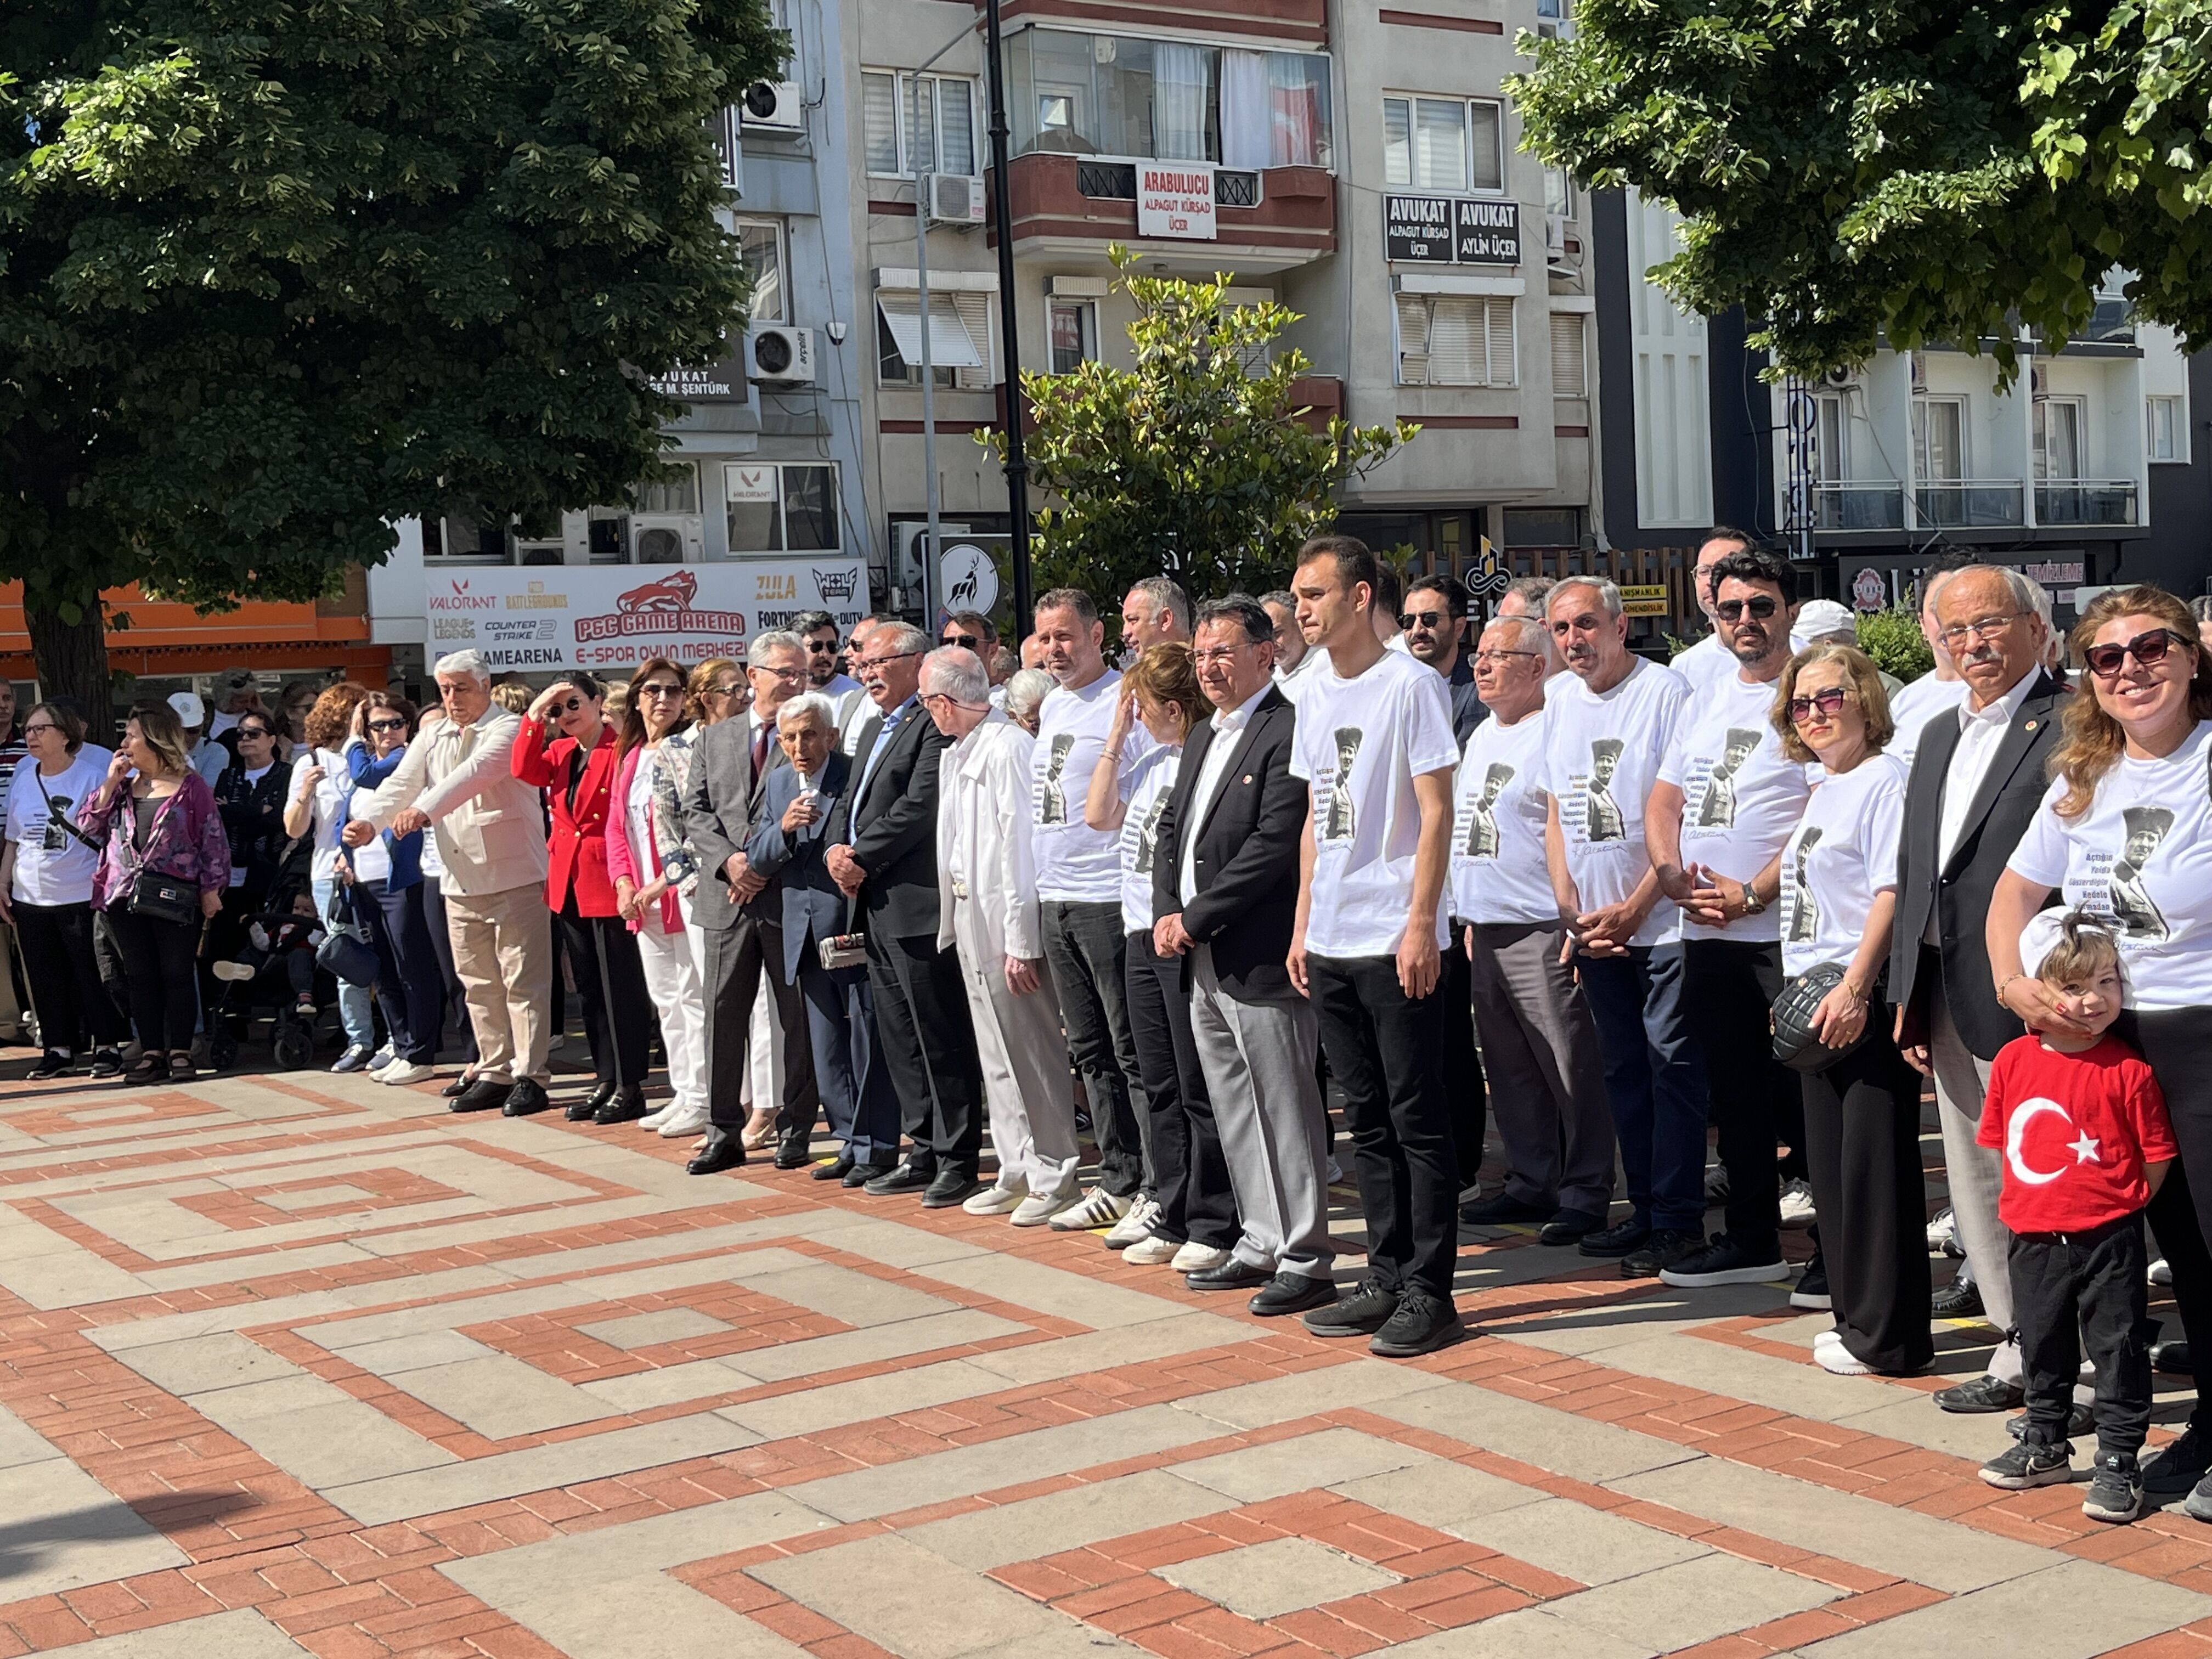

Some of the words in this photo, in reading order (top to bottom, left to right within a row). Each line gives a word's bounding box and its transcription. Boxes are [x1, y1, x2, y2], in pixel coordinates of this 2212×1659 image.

[1144, 172, 1209, 195] ARABULUCU
[1144, 199, 1178, 212] ALPAGUT
[1181, 198, 1211, 216] KÜRŞAD
[1390, 199, 1447, 223] AVUKAT
[1169, 215, 1188, 233] ÜÇER
[1460, 204, 1515, 228] AVUKAT
[1389, 225, 1420, 238] ALPAGUT
[1422, 224, 1449, 241] KÜRŞAD
[1410, 241, 1429, 258] ÜÇER
[1462, 233, 1489, 255] AYLİN
[1492, 235, 1517, 259] ÜÇER
[681, 381, 730, 396] ŞENTÜRK
[2026, 560, 2083, 583] TEMİZLEME
[755, 575, 798, 600] ZULA
[1620, 588, 1660, 597] ANIŞMANLIK
[430, 596, 498, 610] VALORANT
[506, 594, 568, 610] BATTLEGROUNDS
[433, 618, 469, 629] LEAGUE
[485, 620, 537, 630] COUNTER
[622, 612, 678, 633] GAME
[681, 612, 742, 632] ARENA
[435, 629, 476, 640] LEGENDS
[493, 631, 533, 641] STRIKE
[483, 648, 563, 665] AMEARENA
[576, 646, 635, 663] E-SPOR
[640, 644, 678, 659] OYUN
